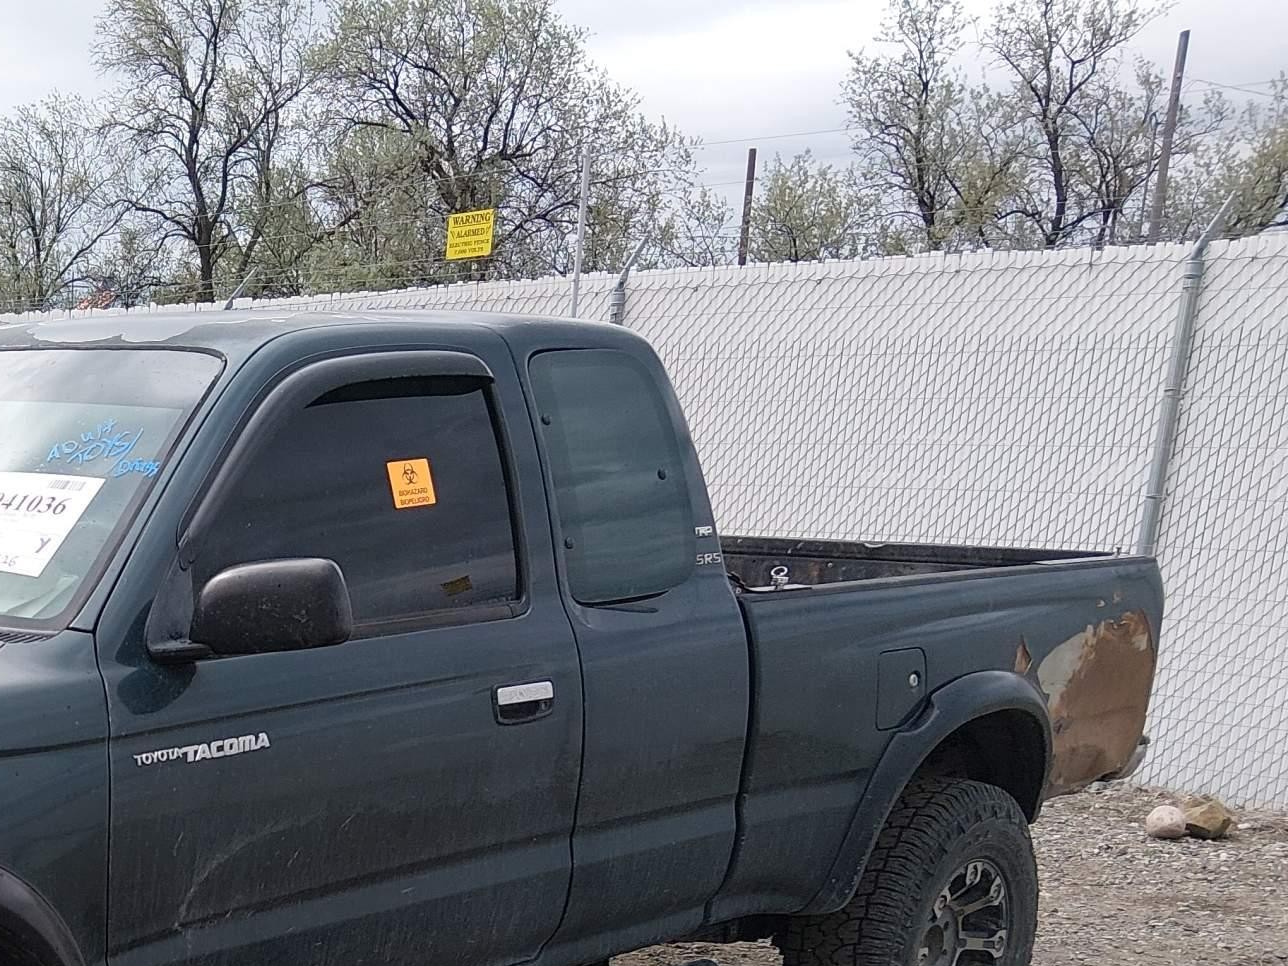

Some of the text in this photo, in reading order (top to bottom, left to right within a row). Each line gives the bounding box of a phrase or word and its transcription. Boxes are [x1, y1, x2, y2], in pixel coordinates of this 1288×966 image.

[453, 212, 491, 225] WARNING
[456, 228, 485, 239] ALARMED
[398, 487, 428, 497] BIOHAZARD
[399, 496, 430, 506] BIOPELIGRO
[133, 732, 271, 766] TOYOTA TACOMA
